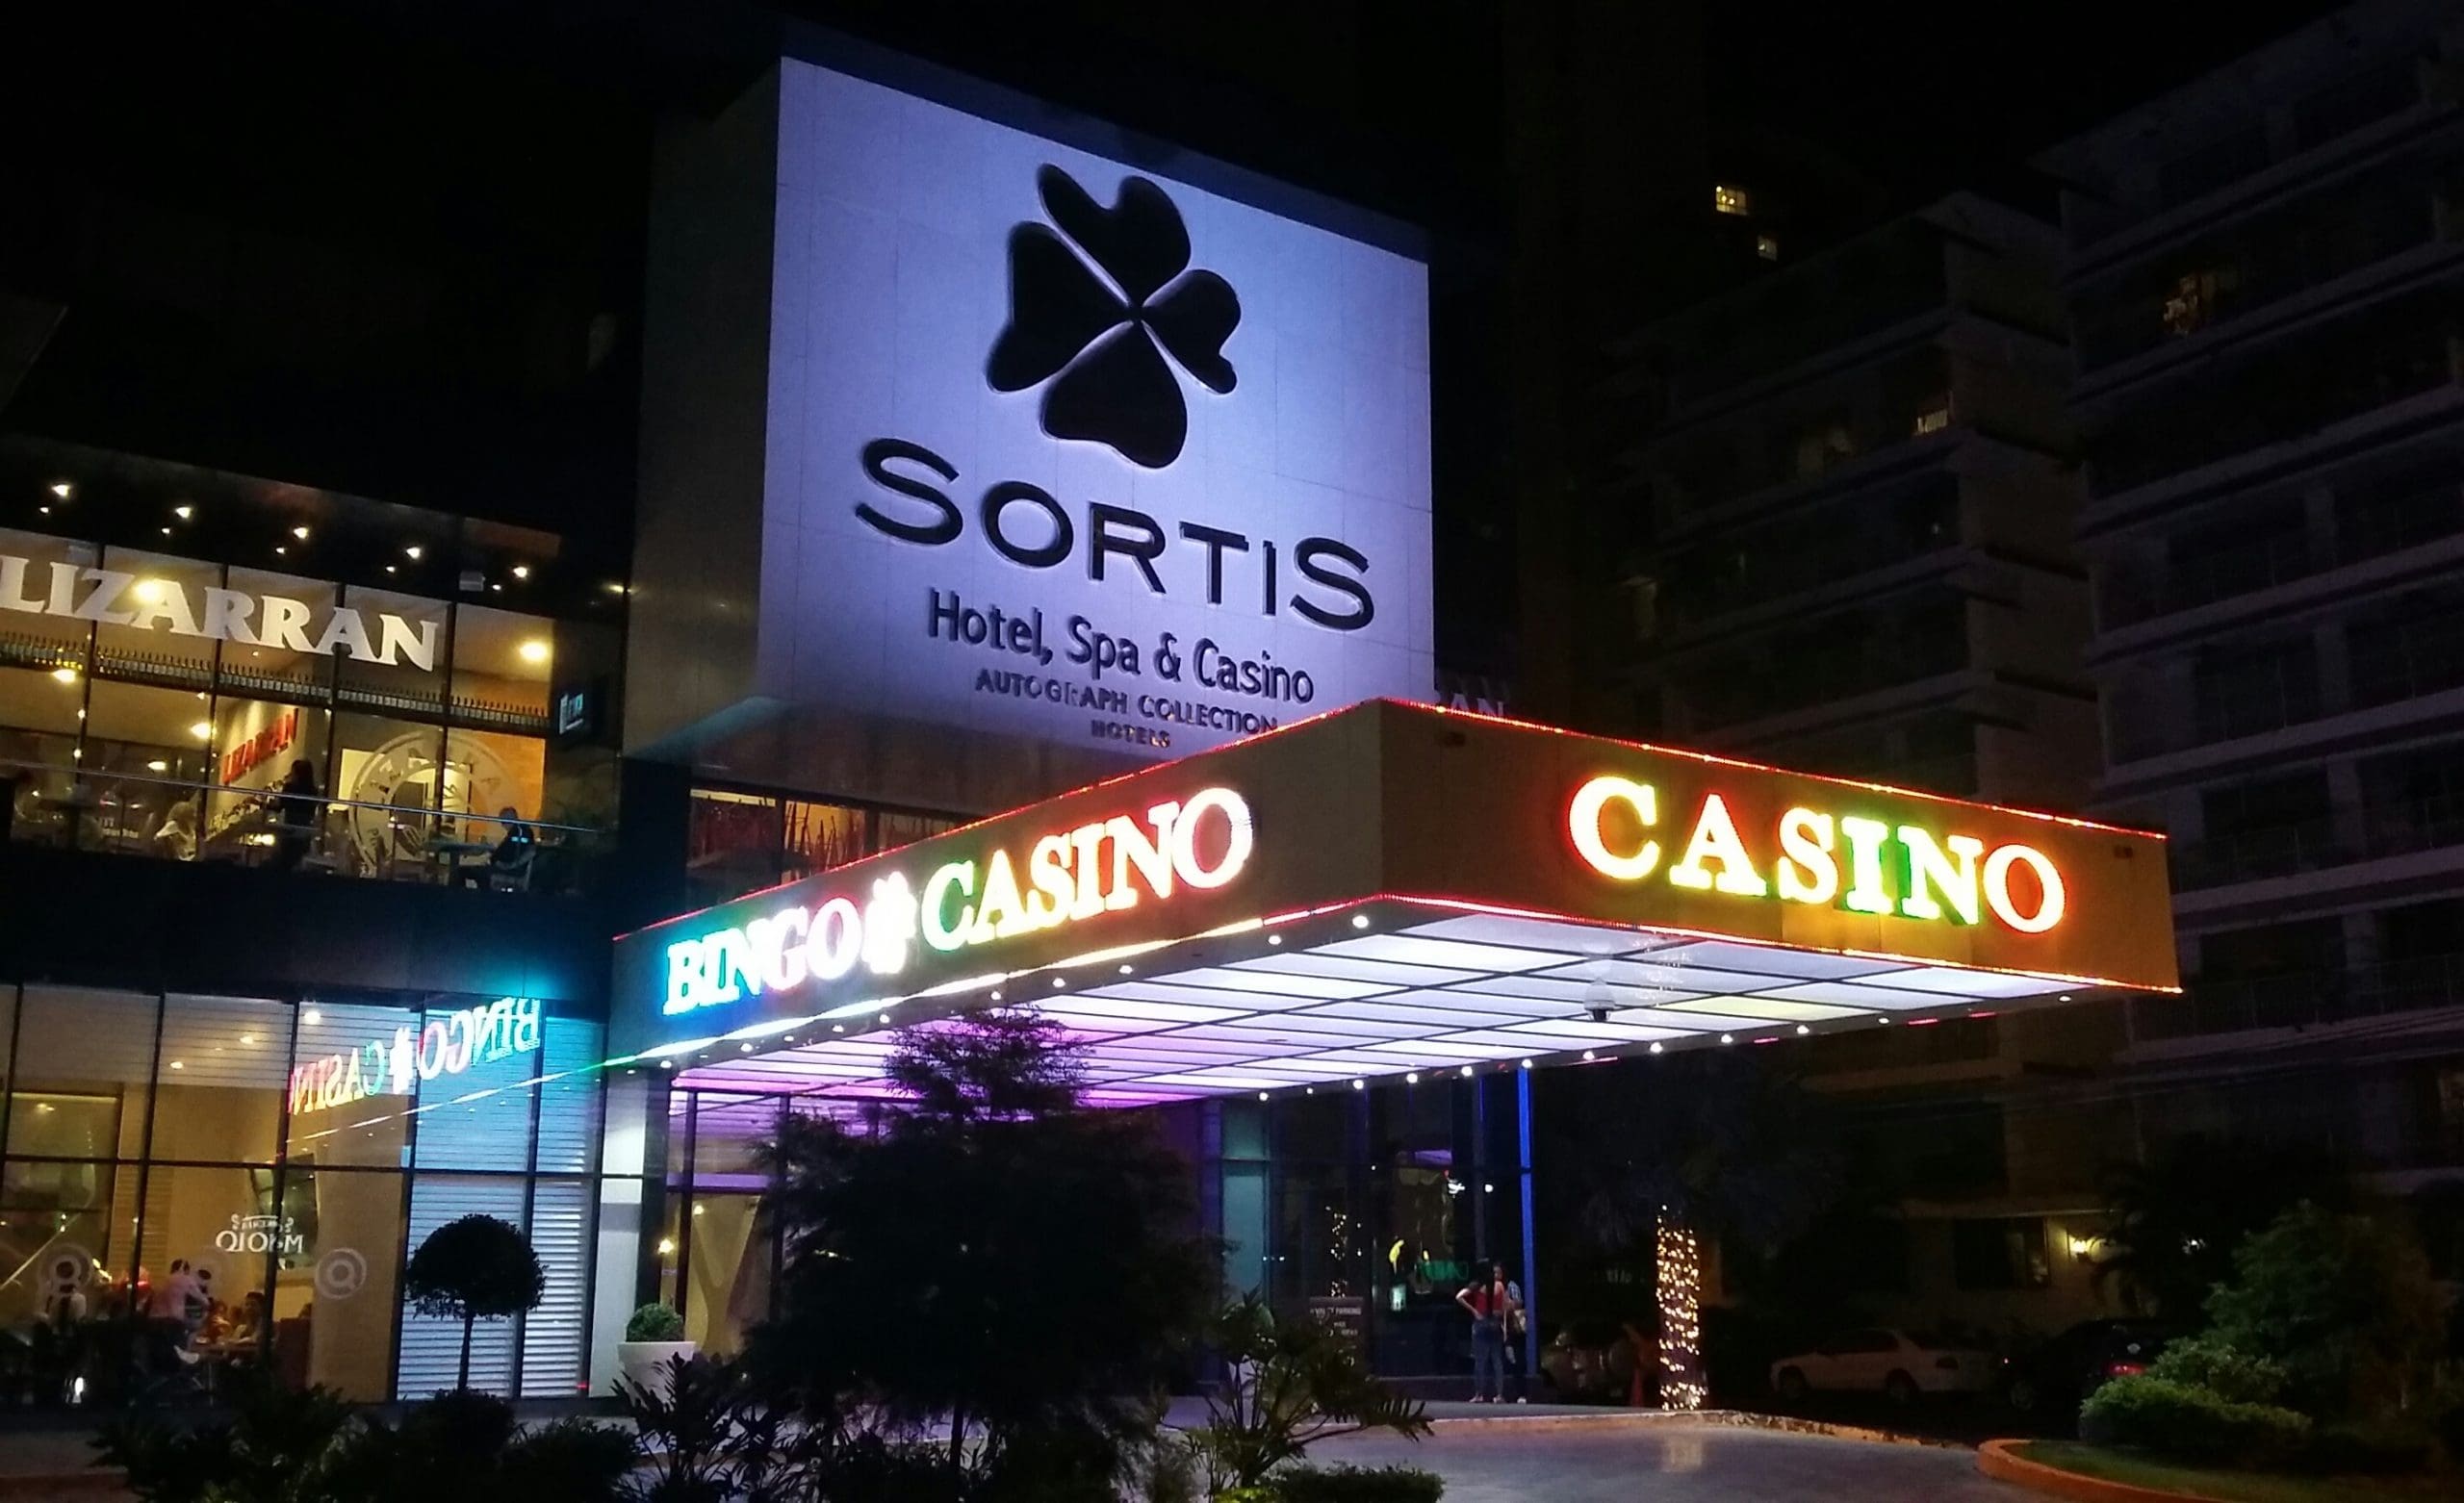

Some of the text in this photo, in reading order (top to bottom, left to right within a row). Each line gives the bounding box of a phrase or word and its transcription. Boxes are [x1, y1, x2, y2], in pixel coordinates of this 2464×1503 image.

[856, 438, 1375, 630] SORTIS
[0, 554, 439, 672] LIZARRAN
[928, 587, 1316, 704] Hotel, Spa & Casino
[975, 669, 1278, 734] AUTOGRAPH COLLECTION
[1091, 719, 1171, 749] HOTELS
[662, 787, 1253, 1015] BINGO CASINO
[1568, 776, 2066, 934] CASINO
